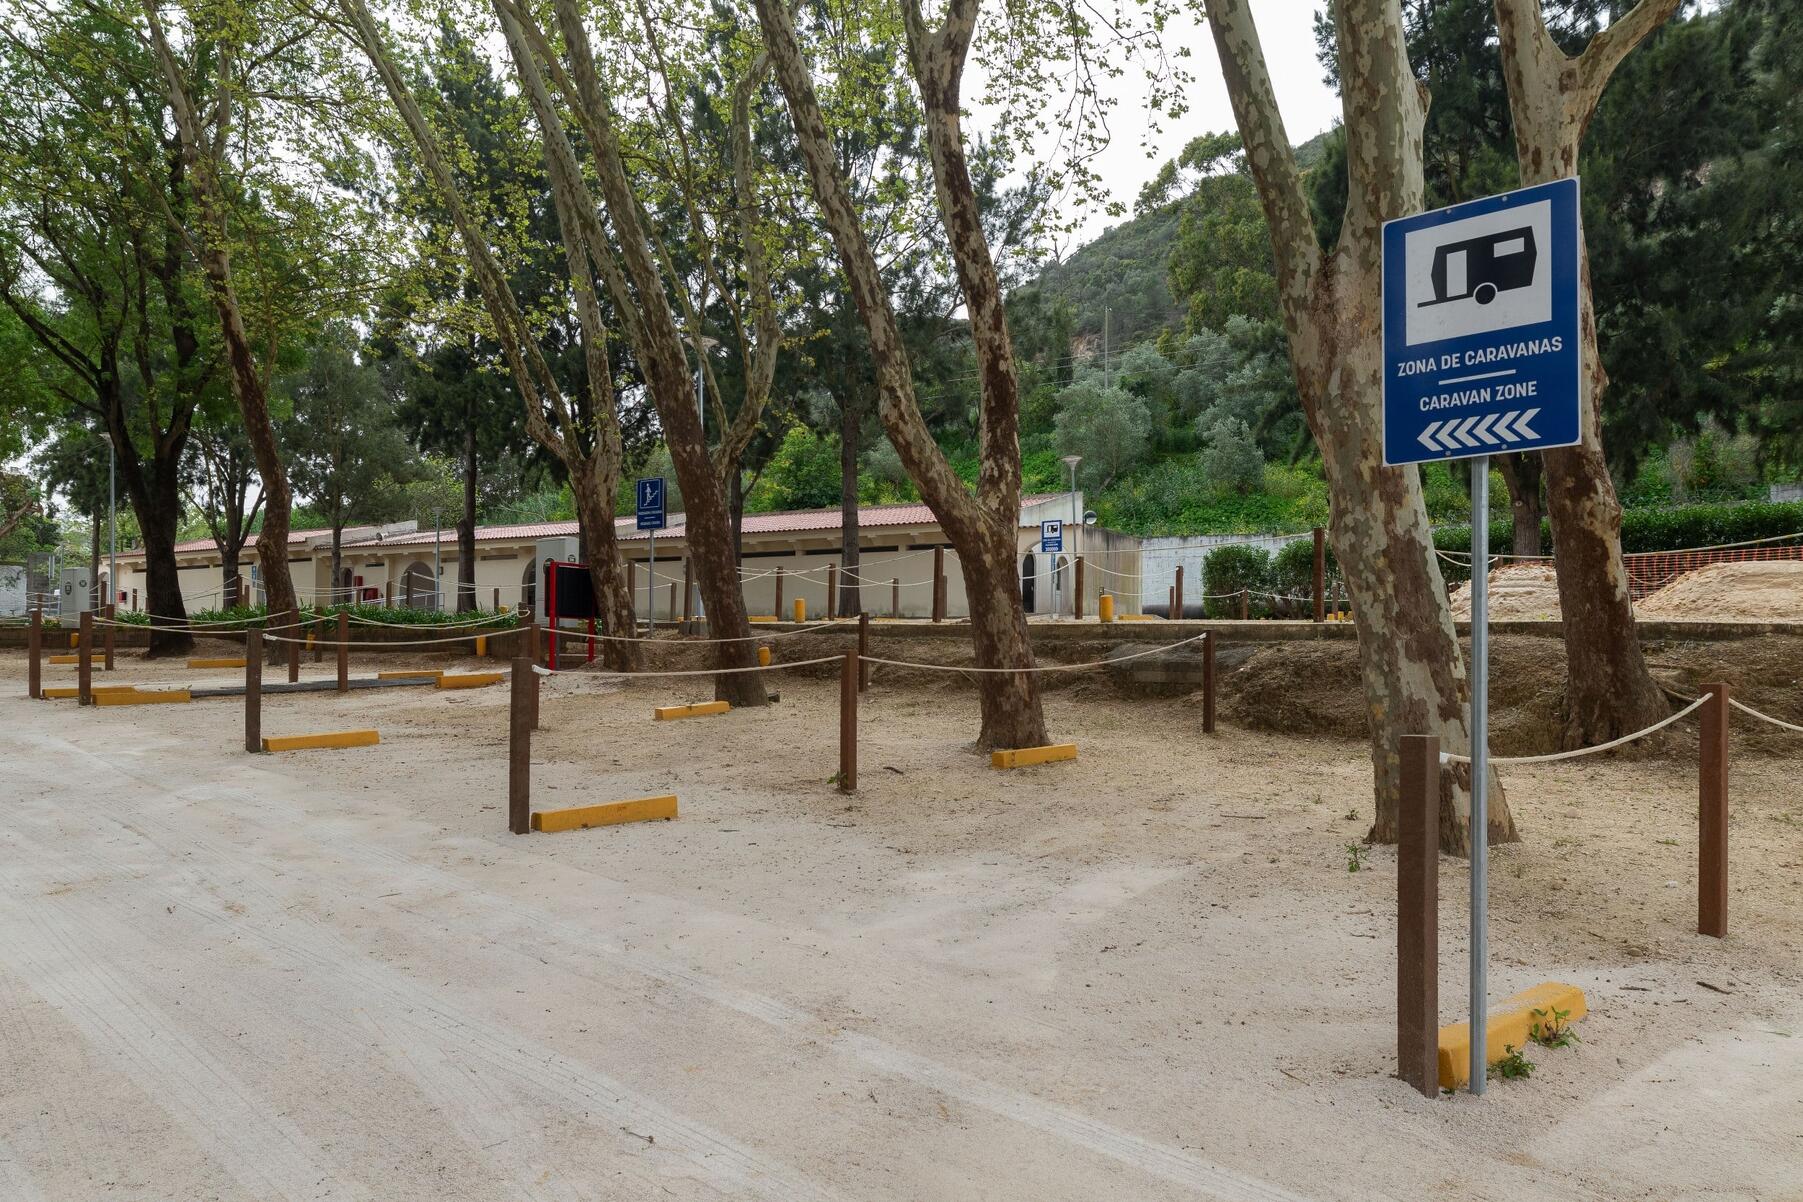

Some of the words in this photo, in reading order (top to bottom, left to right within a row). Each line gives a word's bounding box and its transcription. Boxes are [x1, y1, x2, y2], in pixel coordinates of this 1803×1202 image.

[1397, 357, 1437, 377] ZONA
[1441, 353, 1461, 369] DE
[1464, 336, 1563, 365] CARAVANAS
[1419, 388, 1491, 412] CARAVAN
[1495, 380, 1538, 401] ZONE
